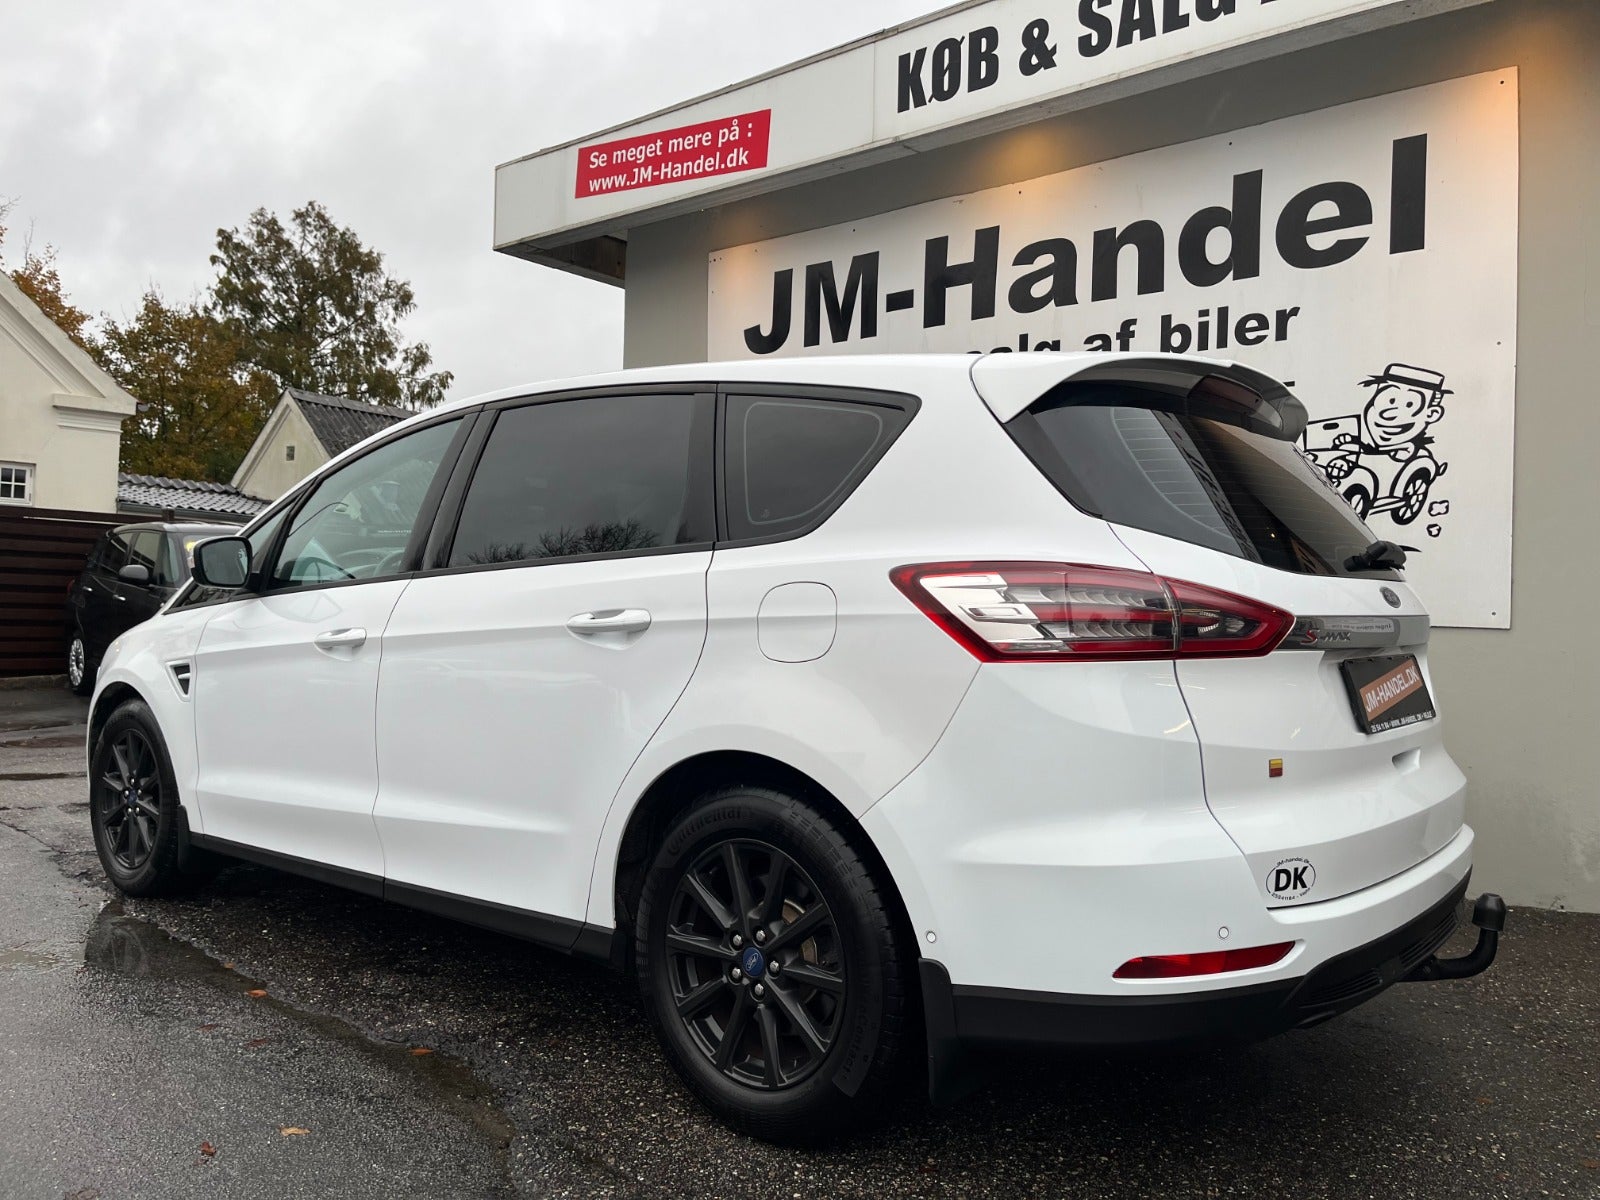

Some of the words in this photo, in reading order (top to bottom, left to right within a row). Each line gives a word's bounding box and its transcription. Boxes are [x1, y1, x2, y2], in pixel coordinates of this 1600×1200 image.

[897, 25, 1000, 113] KØB
[1018, 17, 1058, 77] &
[1077, 0, 1236, 58] SAL
[588, 151, 608, 169] Se
[612, 139, 663, 164] meget
[667, 132, 712, 153] mere
[718, 119, 740, 148] på
[588, 147, 750, 193] www.JM-Handel.dk
[743, 133, 1426, 355] JM-Handel
[1083, 318, 1137, 352] af
[1160, 306, 1301, 354] biler
[1366, 666, 1420, 713] JM-HANDEL.DK
[1274, 865, 1309, 892] DK
